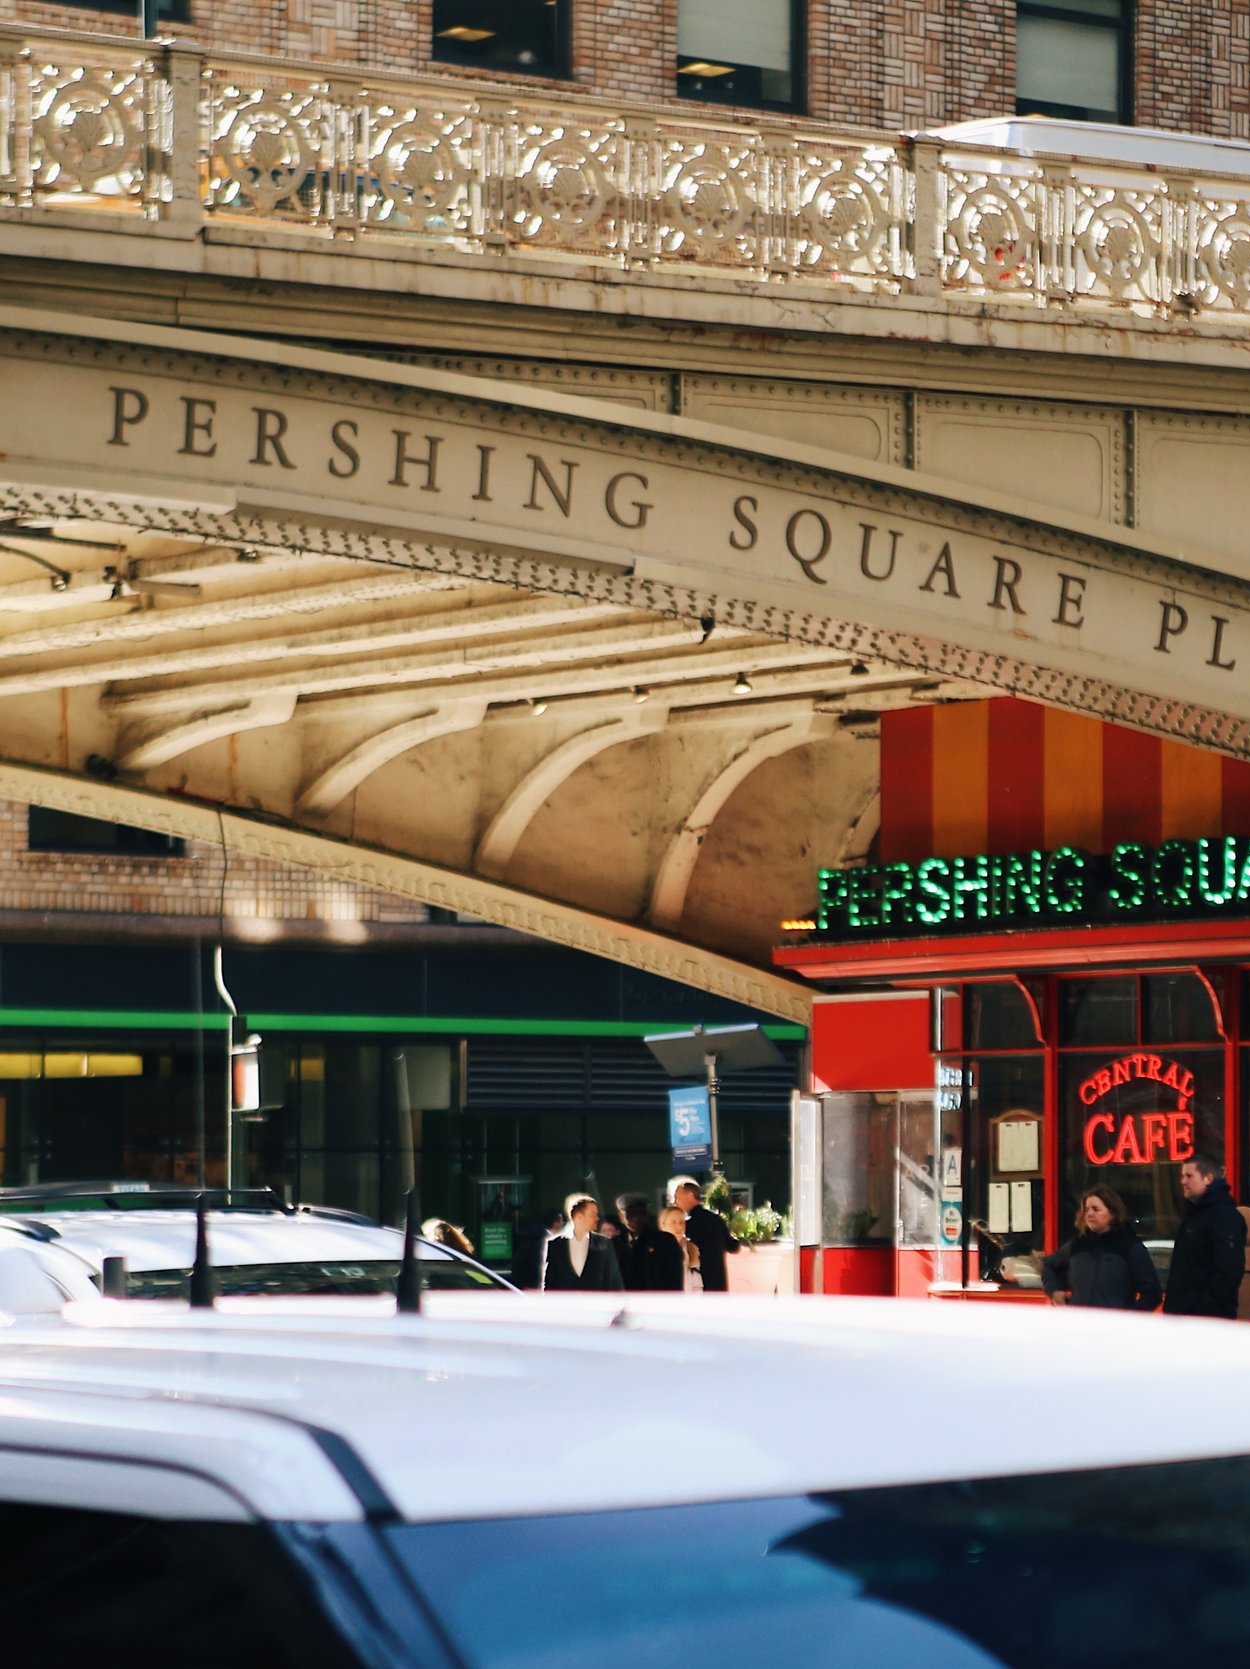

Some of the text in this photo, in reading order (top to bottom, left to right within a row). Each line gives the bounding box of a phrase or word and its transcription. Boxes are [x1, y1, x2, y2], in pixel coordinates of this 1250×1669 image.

[107, 385, 654, 530] PERSHING
[729, 495, 1088, 629] SQUARE
[816, 845, 1085, 931] PERSHING
[1078, 1053, 1195, 1106] CENTRAL
[946, 1155, 958, 1176] A
